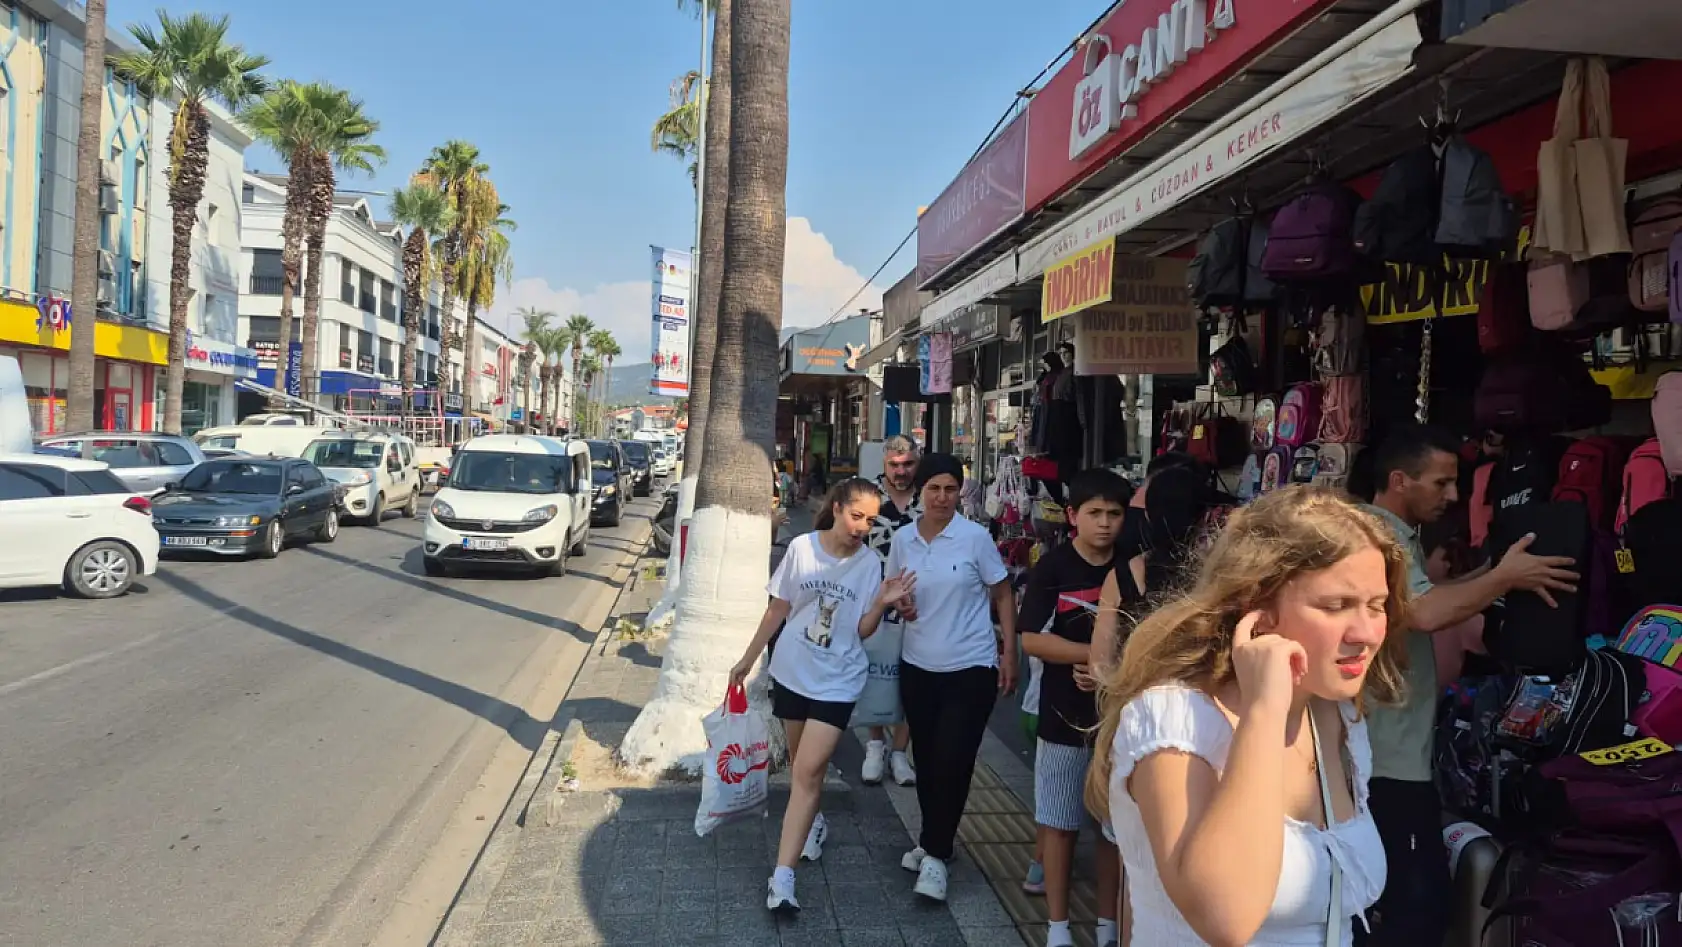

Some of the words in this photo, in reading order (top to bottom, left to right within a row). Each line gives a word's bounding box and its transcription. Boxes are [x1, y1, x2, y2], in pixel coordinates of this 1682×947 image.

[1078, 86, 1103, 138] ÖZ
[1151, 162, 1198, 204] CÜZDAN
[1205, 154, 1213, 172] &
[1227, 111, 1281, 160] KEMER
[1047, 243, 1112, 316] İNDİRİM
